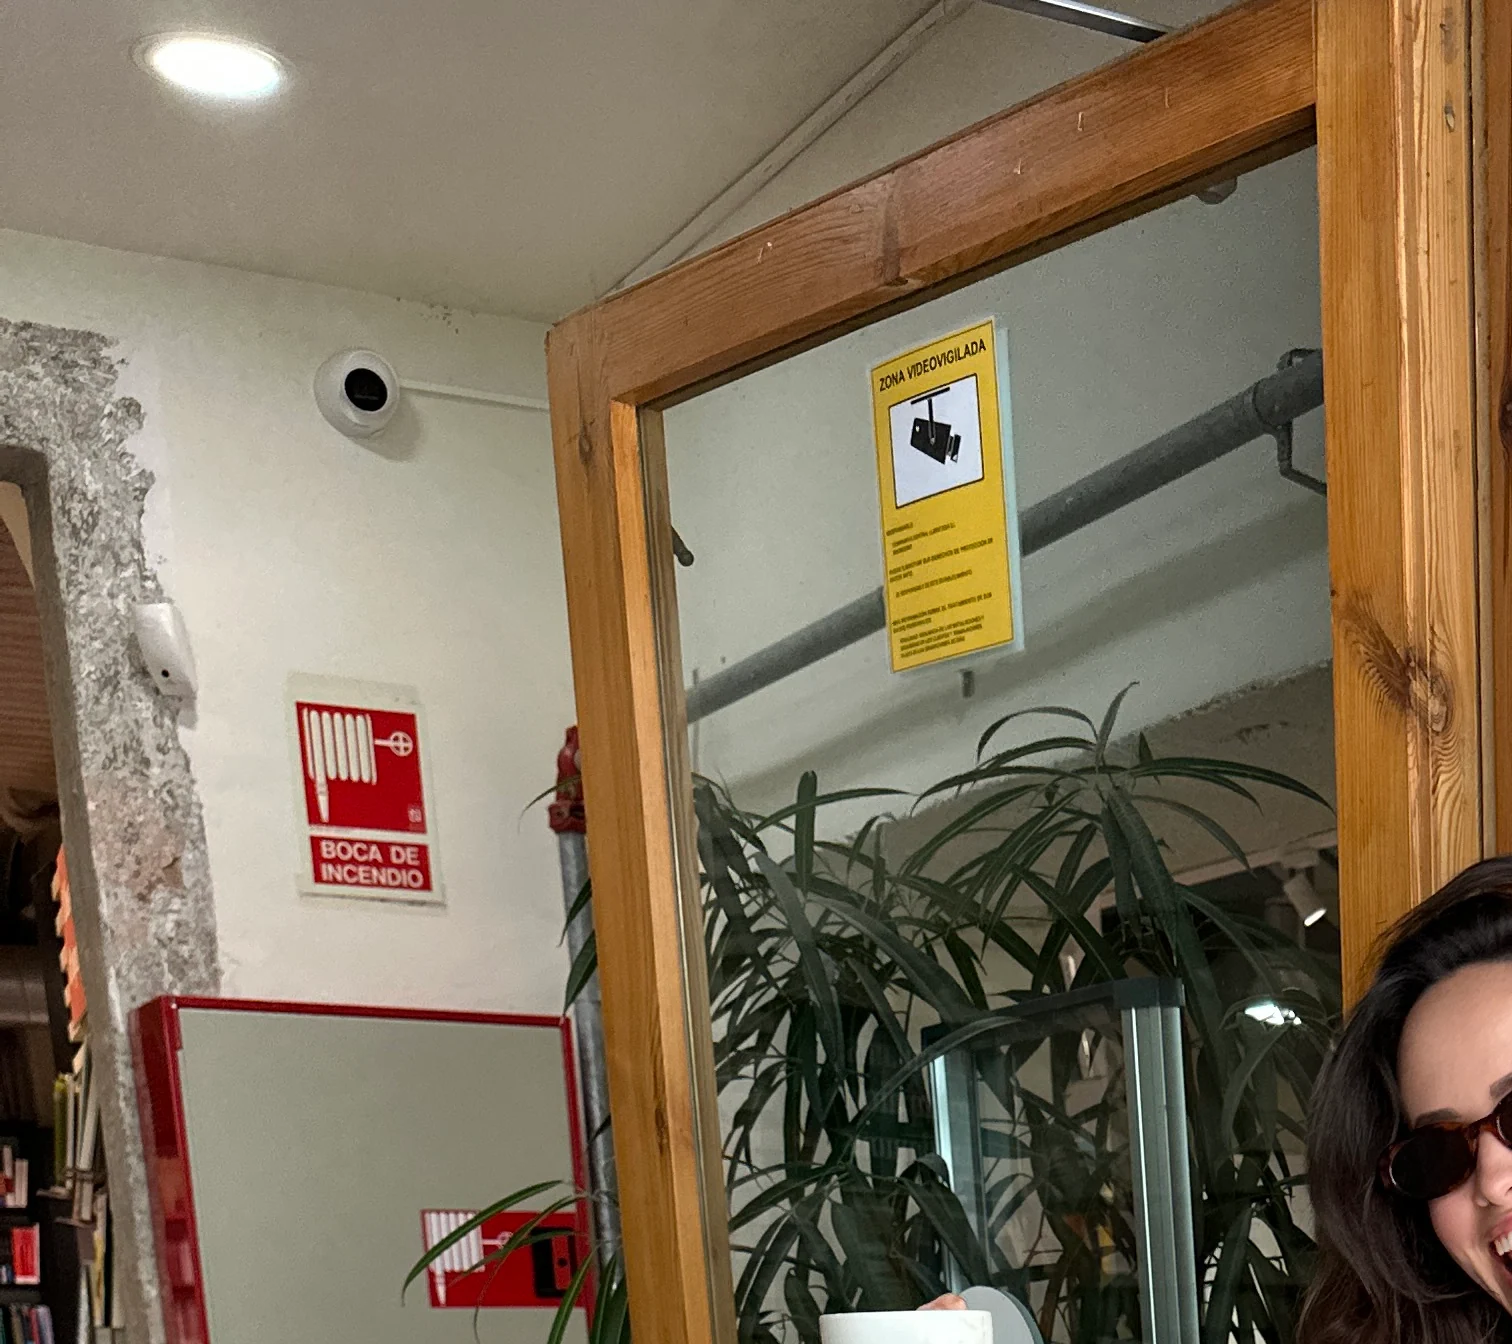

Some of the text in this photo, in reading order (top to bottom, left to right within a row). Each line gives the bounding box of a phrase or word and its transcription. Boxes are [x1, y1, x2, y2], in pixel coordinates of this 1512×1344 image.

[879, 338, 987, 392] ZONA VIDEOVIGILADA
[320, 839, 421, 866] BOCA DE
[321, 862, 424, 888] INCENDIO
